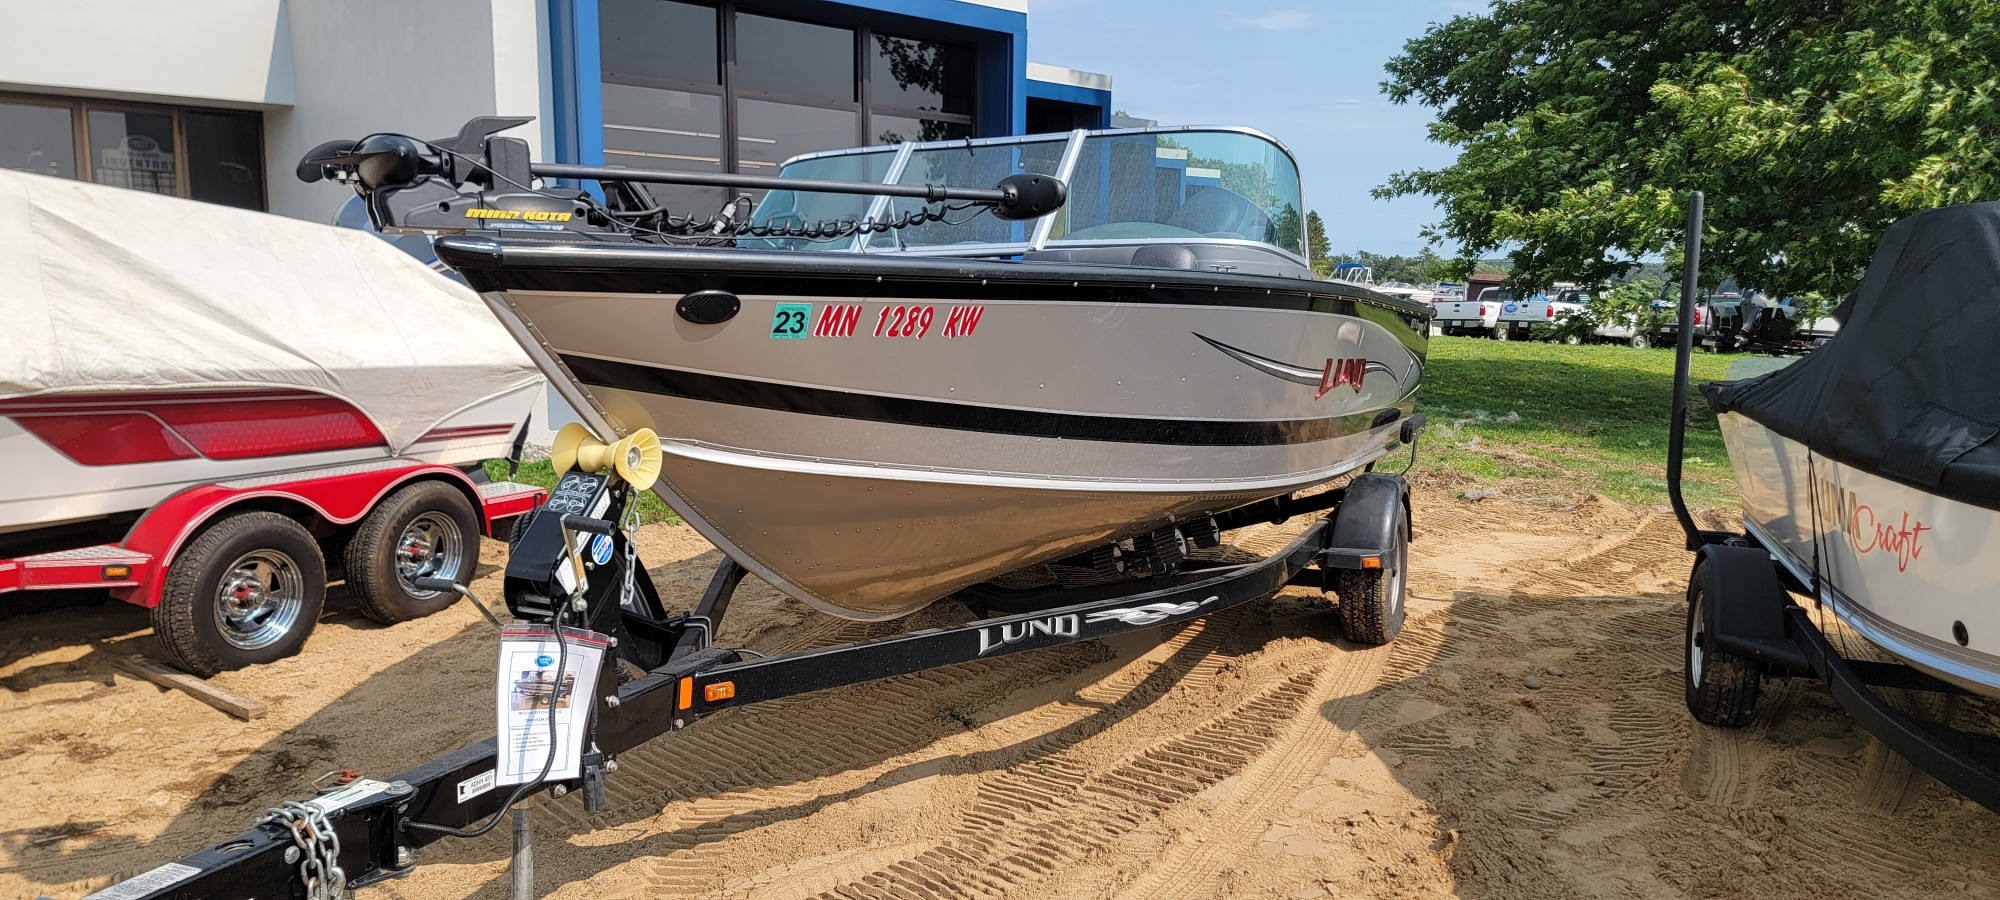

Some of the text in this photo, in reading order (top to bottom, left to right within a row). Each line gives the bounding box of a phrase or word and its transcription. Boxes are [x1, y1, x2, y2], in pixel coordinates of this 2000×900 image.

[522, 211, 572, 221] KOTA
[772, 311, 805, 334] 23
[812, 304, 863, 337] MN
[872, 305, 934, 340] 1289
[941, 305, 985, 339] KW
[1315, 358, 1367, 400] LUND
[1851, 504, 1932, 573] Craft
[978, 613, 1081, 657] LUND
